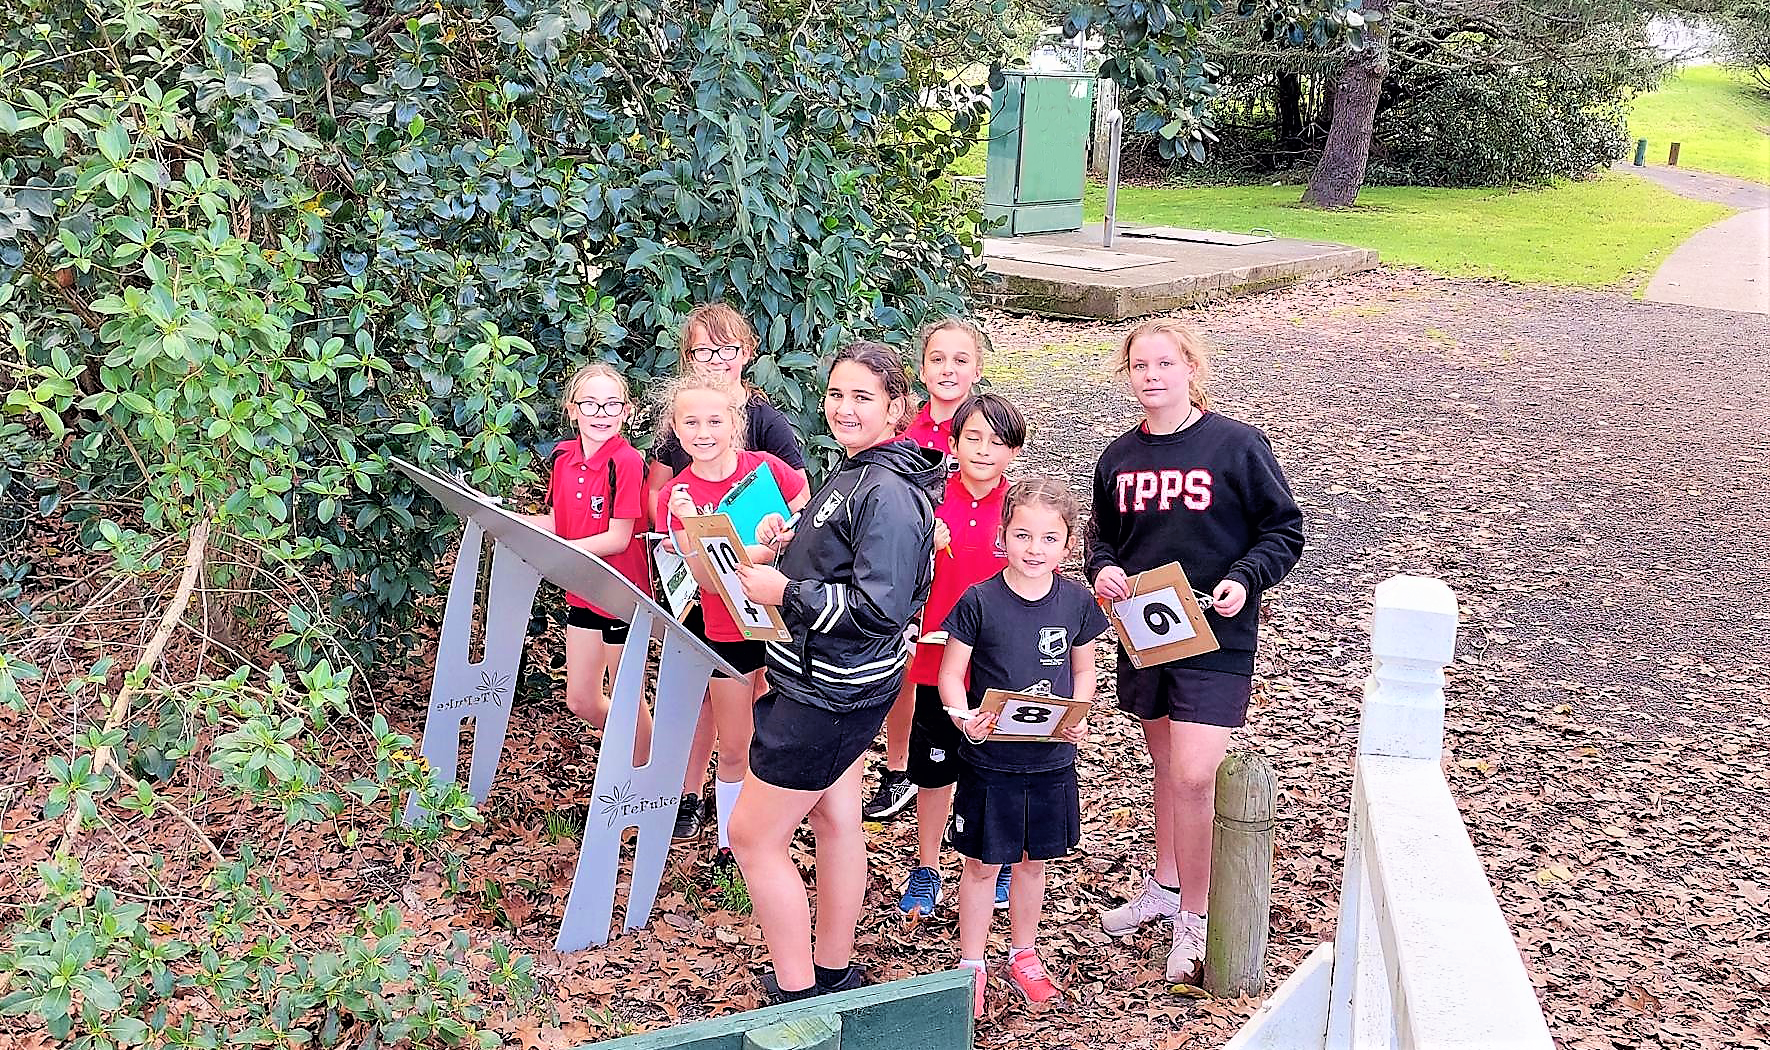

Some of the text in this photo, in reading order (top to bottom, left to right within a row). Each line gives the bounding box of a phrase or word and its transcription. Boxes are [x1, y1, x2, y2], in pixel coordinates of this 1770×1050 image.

[1116, 468, 1214, 512] TPPS
[706, 542, 740, 574] 10
[1011, 706, 1052, 724] 8
